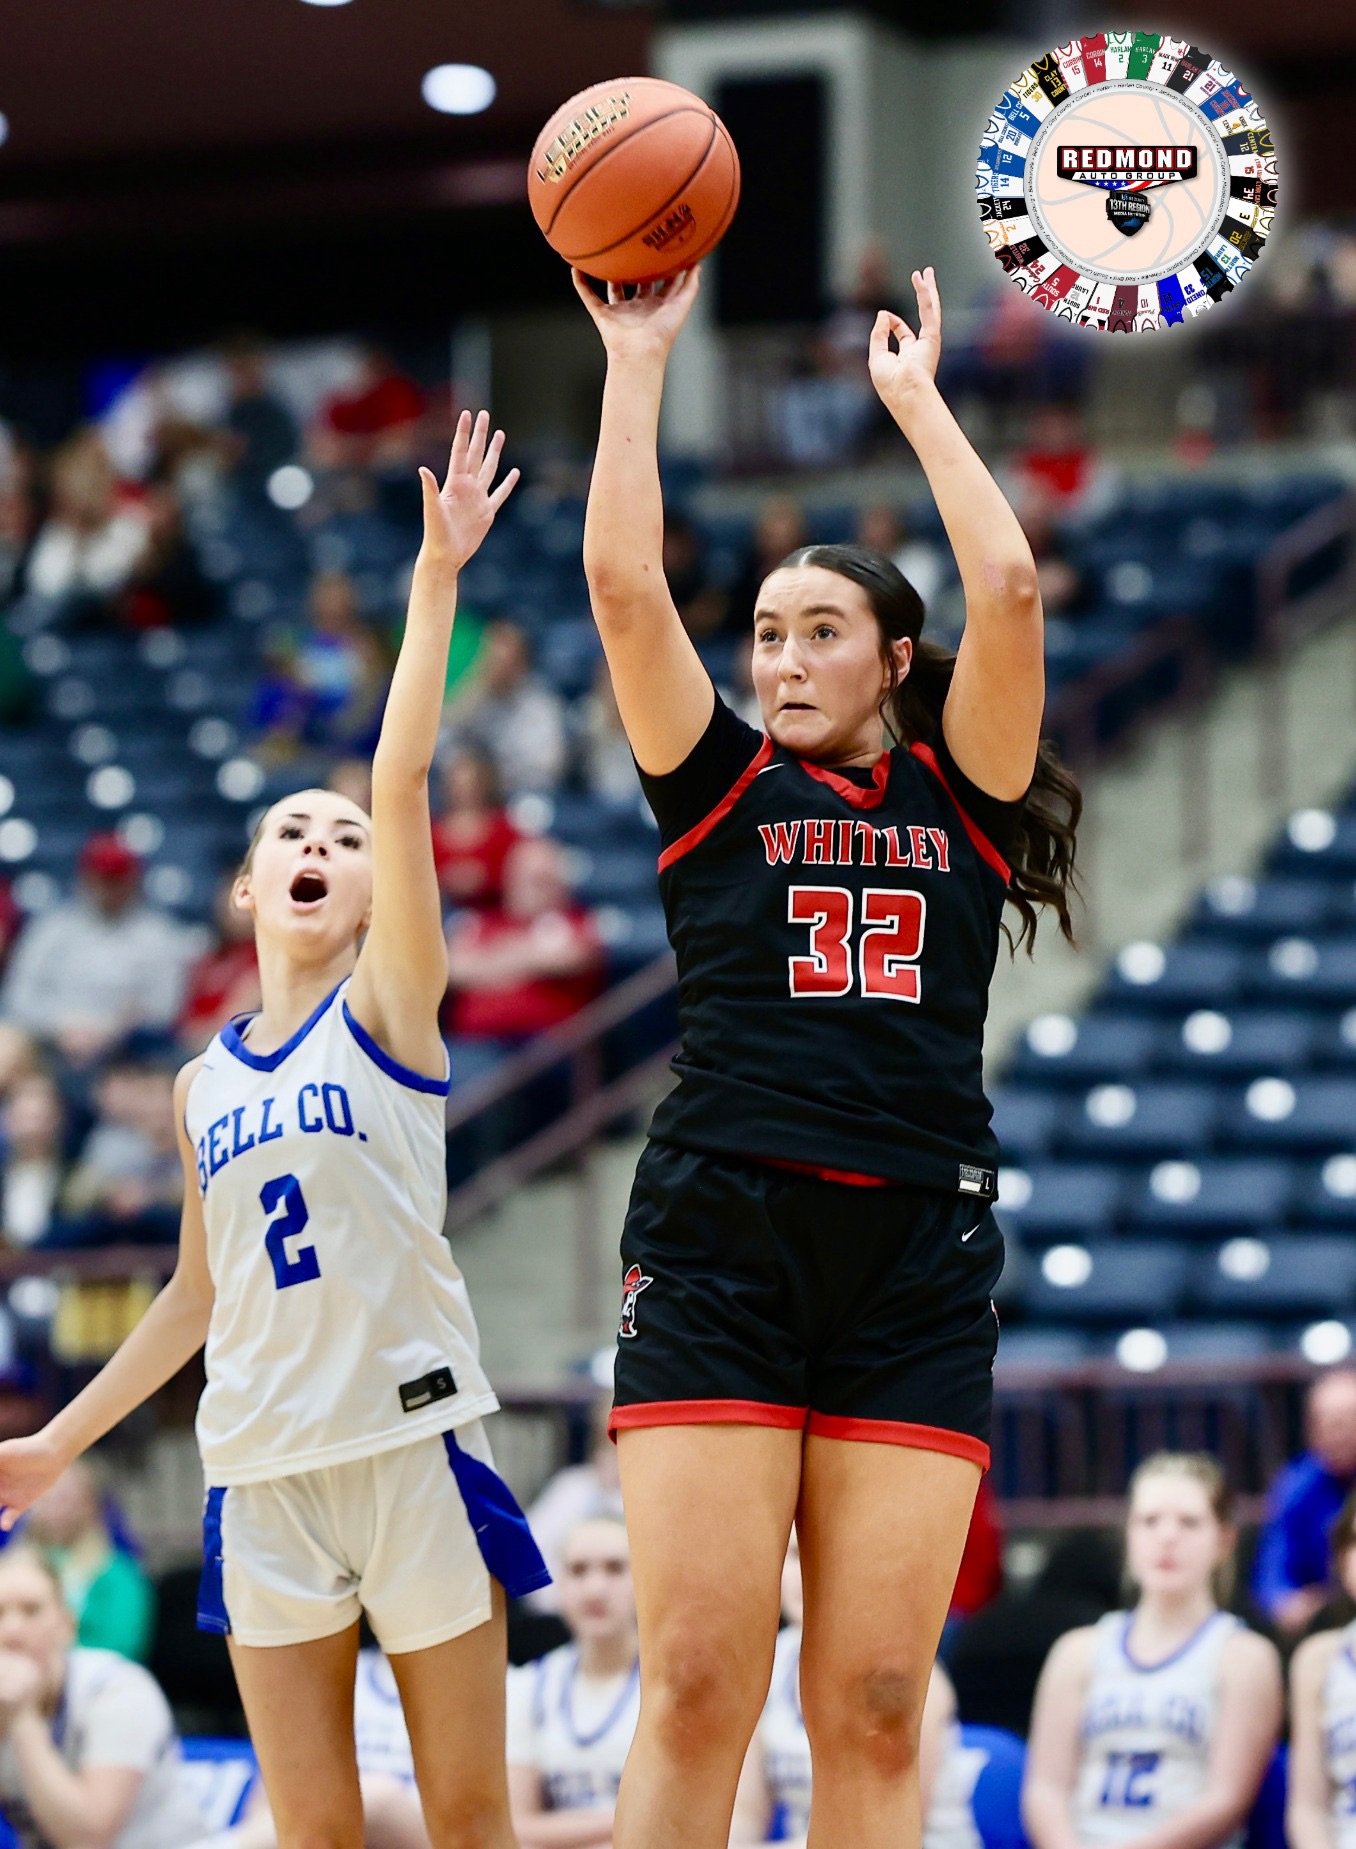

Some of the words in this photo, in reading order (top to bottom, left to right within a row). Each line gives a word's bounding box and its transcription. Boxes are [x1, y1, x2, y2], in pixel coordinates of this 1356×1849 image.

[758, 819, 951, 872] WHITLEY
[787, 884, 927, 1005] 32
[297, 1082, 368, 1143] CO.
[258, 1172, 322, 1291] 2
[436, 1377, 447, 1390] S
